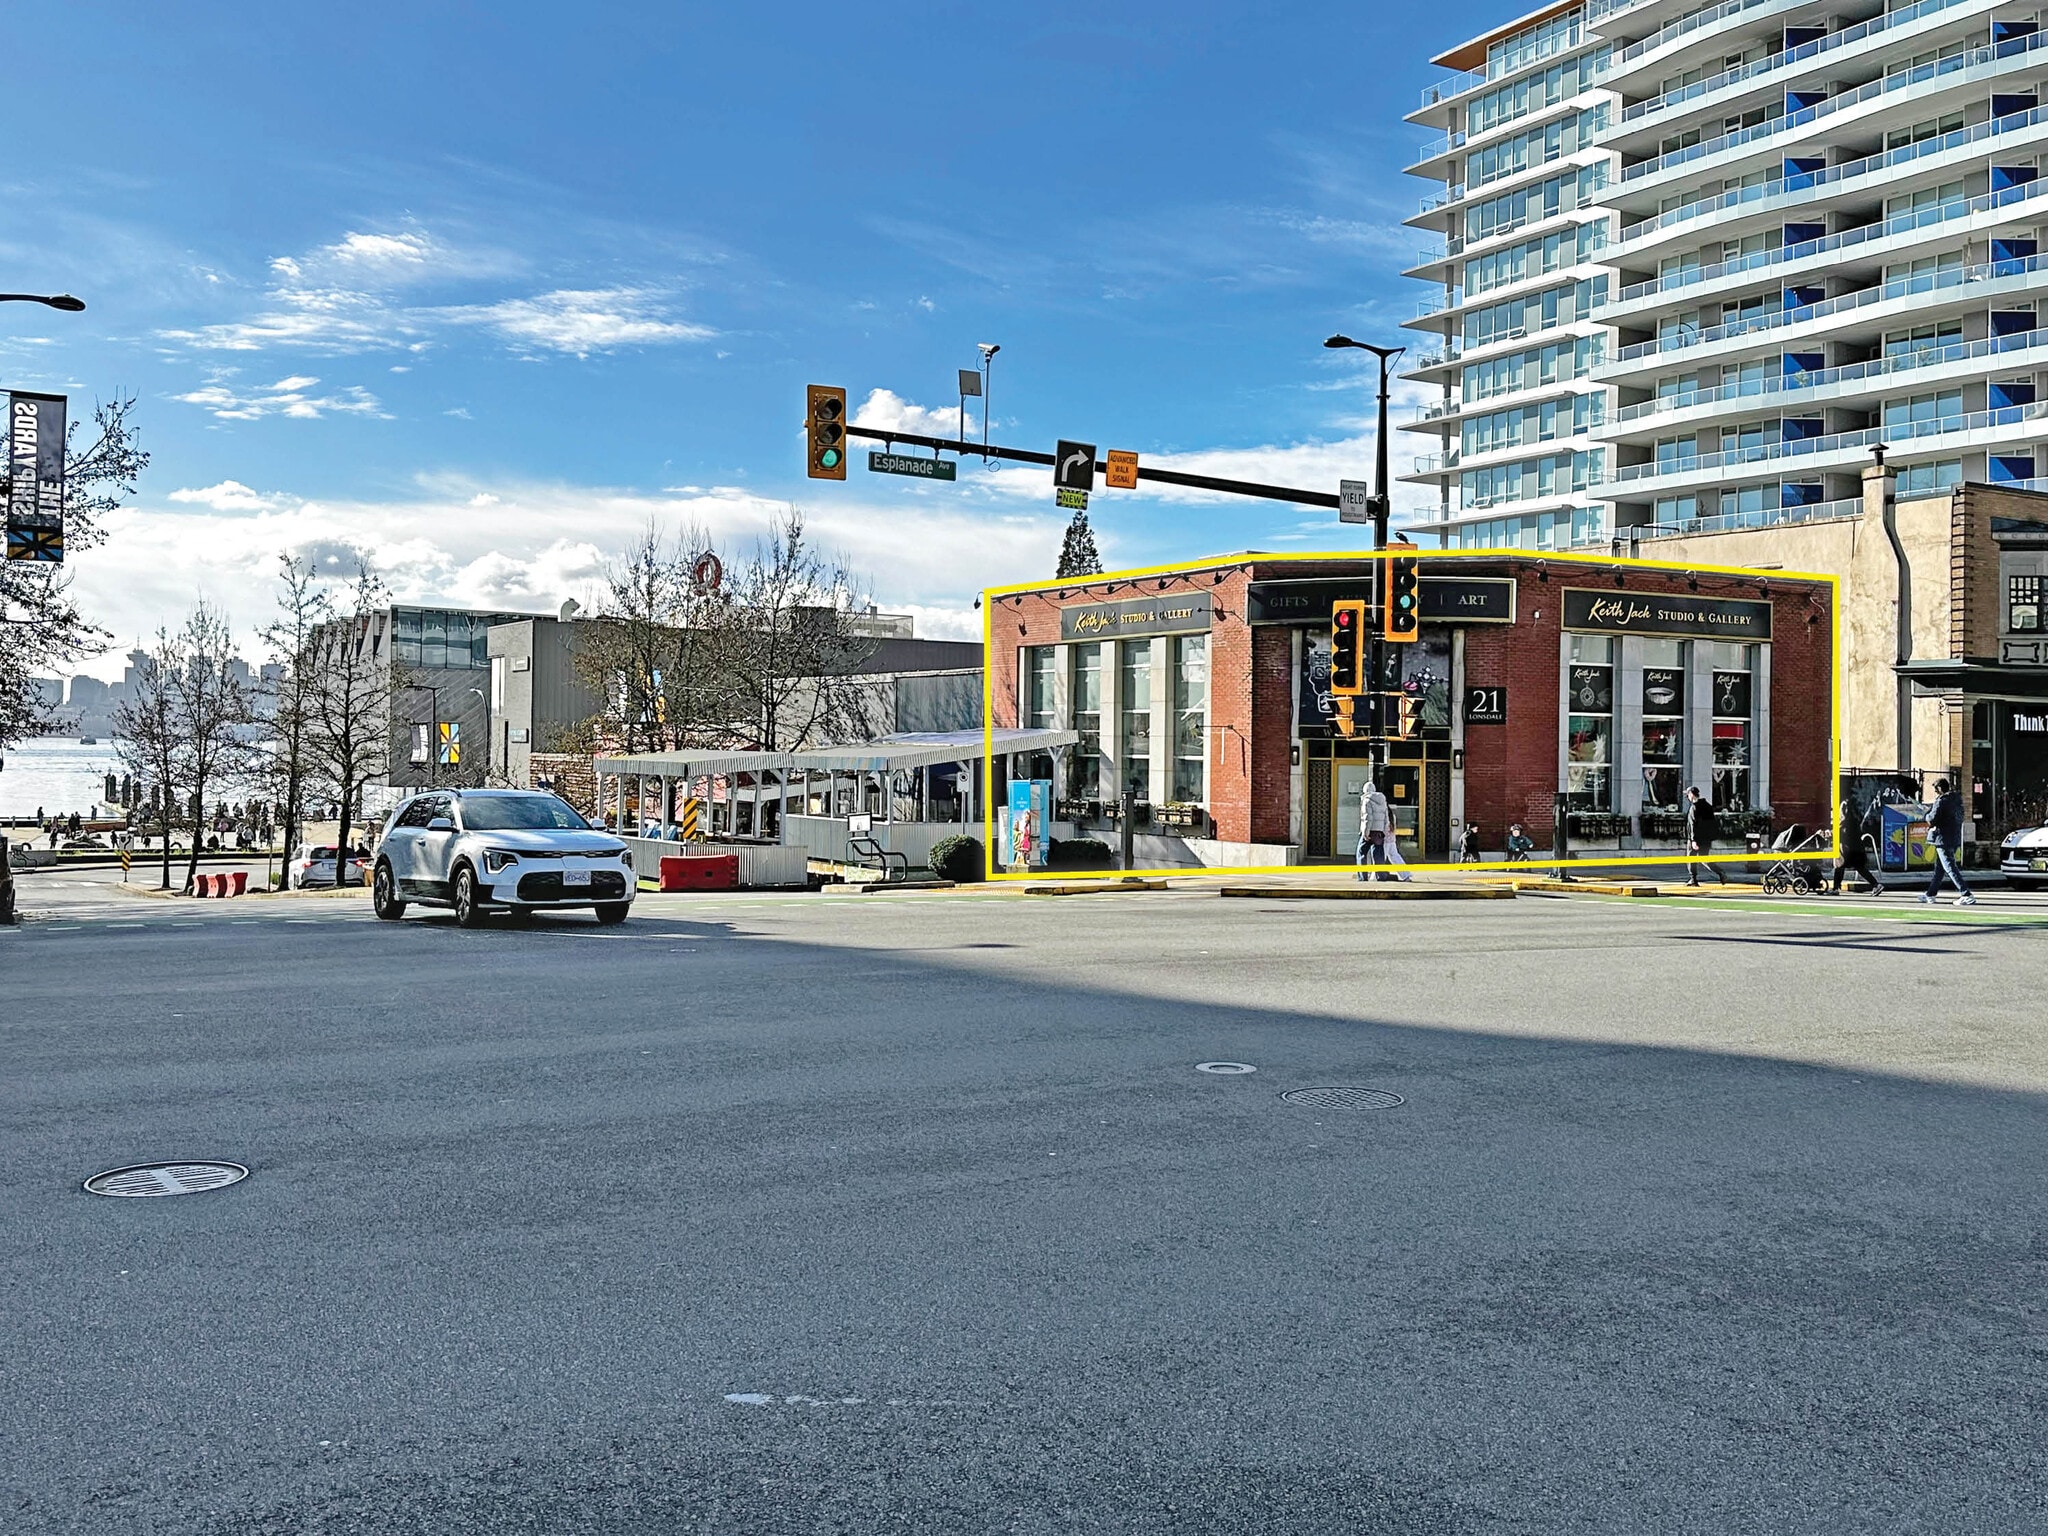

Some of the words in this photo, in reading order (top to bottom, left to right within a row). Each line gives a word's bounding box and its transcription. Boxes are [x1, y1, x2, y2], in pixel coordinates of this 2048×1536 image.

[874, 453, 933, 474] Esplanade
[938, 461, 950, 470] Ave
[1110, 454, 1136, 464] ADVANCED
[1115, 465, 1129, 474] WALK
[1112, 474, 1131, 484] SIGNAL
[1062, 494, 1083, 504] NEW
[1342, 492, 1364, 505] YIELD
[1270, 596, 1309, 608] GIFTS
[1458, 595, 1488, 606] ART
[1588, 597, 1625, 623] Keith
[1616, 601, 1652, 625] Jack
[1657, 609, 1695, 622] STUDIO
[1698, 612, 1705, 623] &
[1708, 613, 1752, 625] GALLERY
[1074, 610, 1099, 634] Keith
[1120, 613, 1147, 624] STUDIO
[1149, 611, 1156, 621] &
[1159, 608, 1194, 620] GALLERY
[1473, 690, 1500, 712] 21
[2013, 714, 2045, 732] Think
[1885, 822, 1893, 862] RECYCLE
